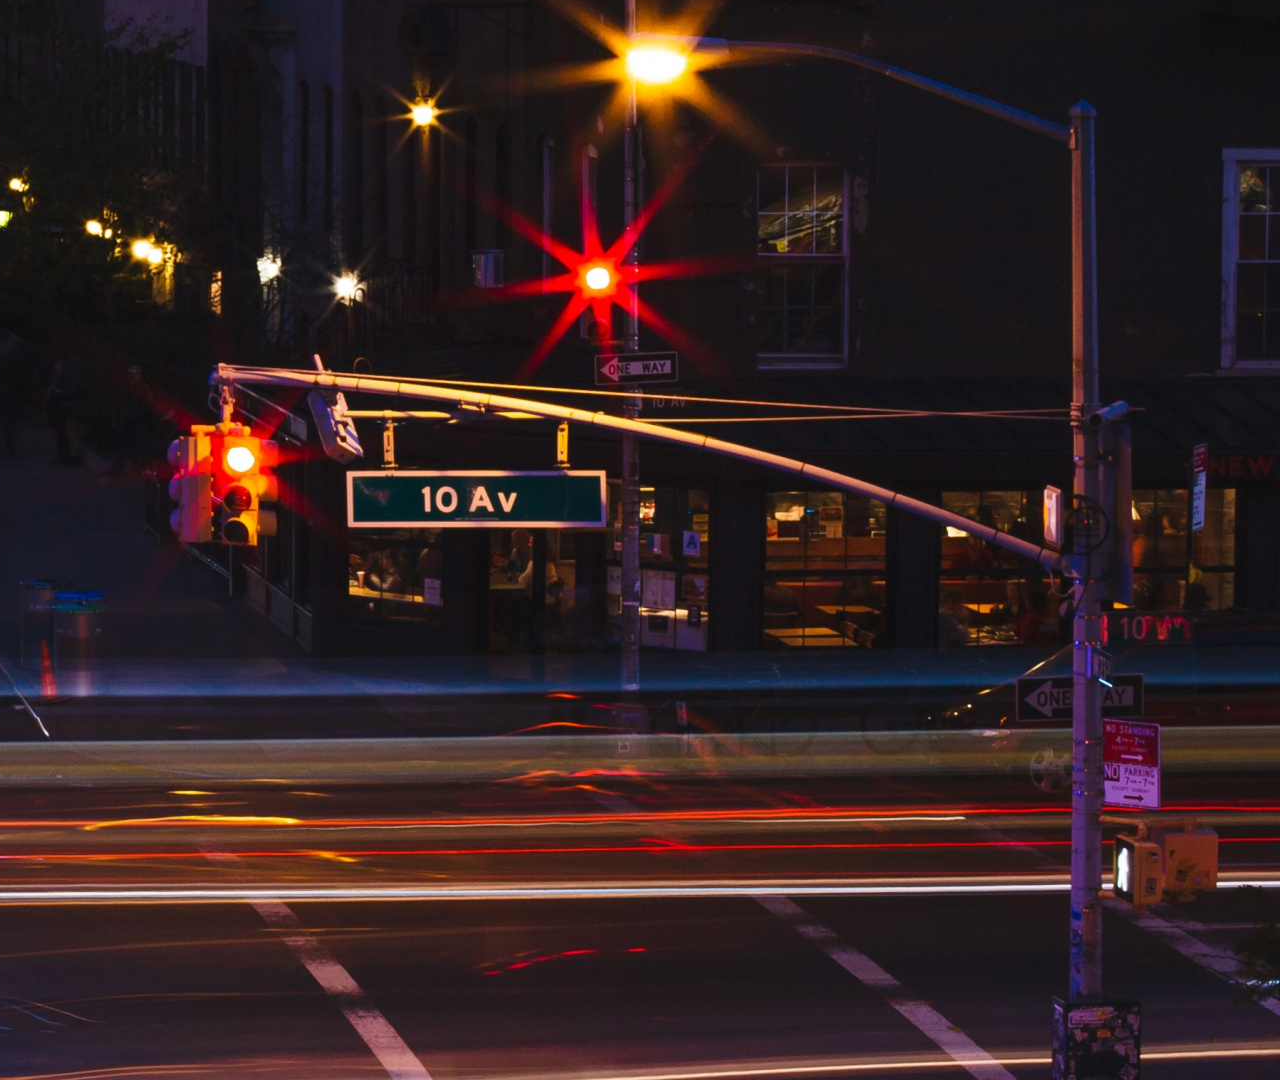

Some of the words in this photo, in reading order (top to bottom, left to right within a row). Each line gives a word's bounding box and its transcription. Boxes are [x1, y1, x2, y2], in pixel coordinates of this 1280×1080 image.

[608, 363, 631, 375] ONE
[642, 361, 666, 373] WAY
[652, 395, 665, 408] 10
[1208, 455, 1275, 476] NEW
[421, 486, 459, 514] 10
[469, 485, 518, 513] Av
[686, 533, 698, 550] A
[1120, 615, 1146, 640] 10
[1036, 690, 1072, 707] ONE
[1102, 687, 1127, 705] AY
[1105, 723, 1116, 734] NO
[1120, 725, 1155, 737] STANDING
[1104, 764, 1119, 779] NO
[1124, 767, 1155, 779] PARKING
